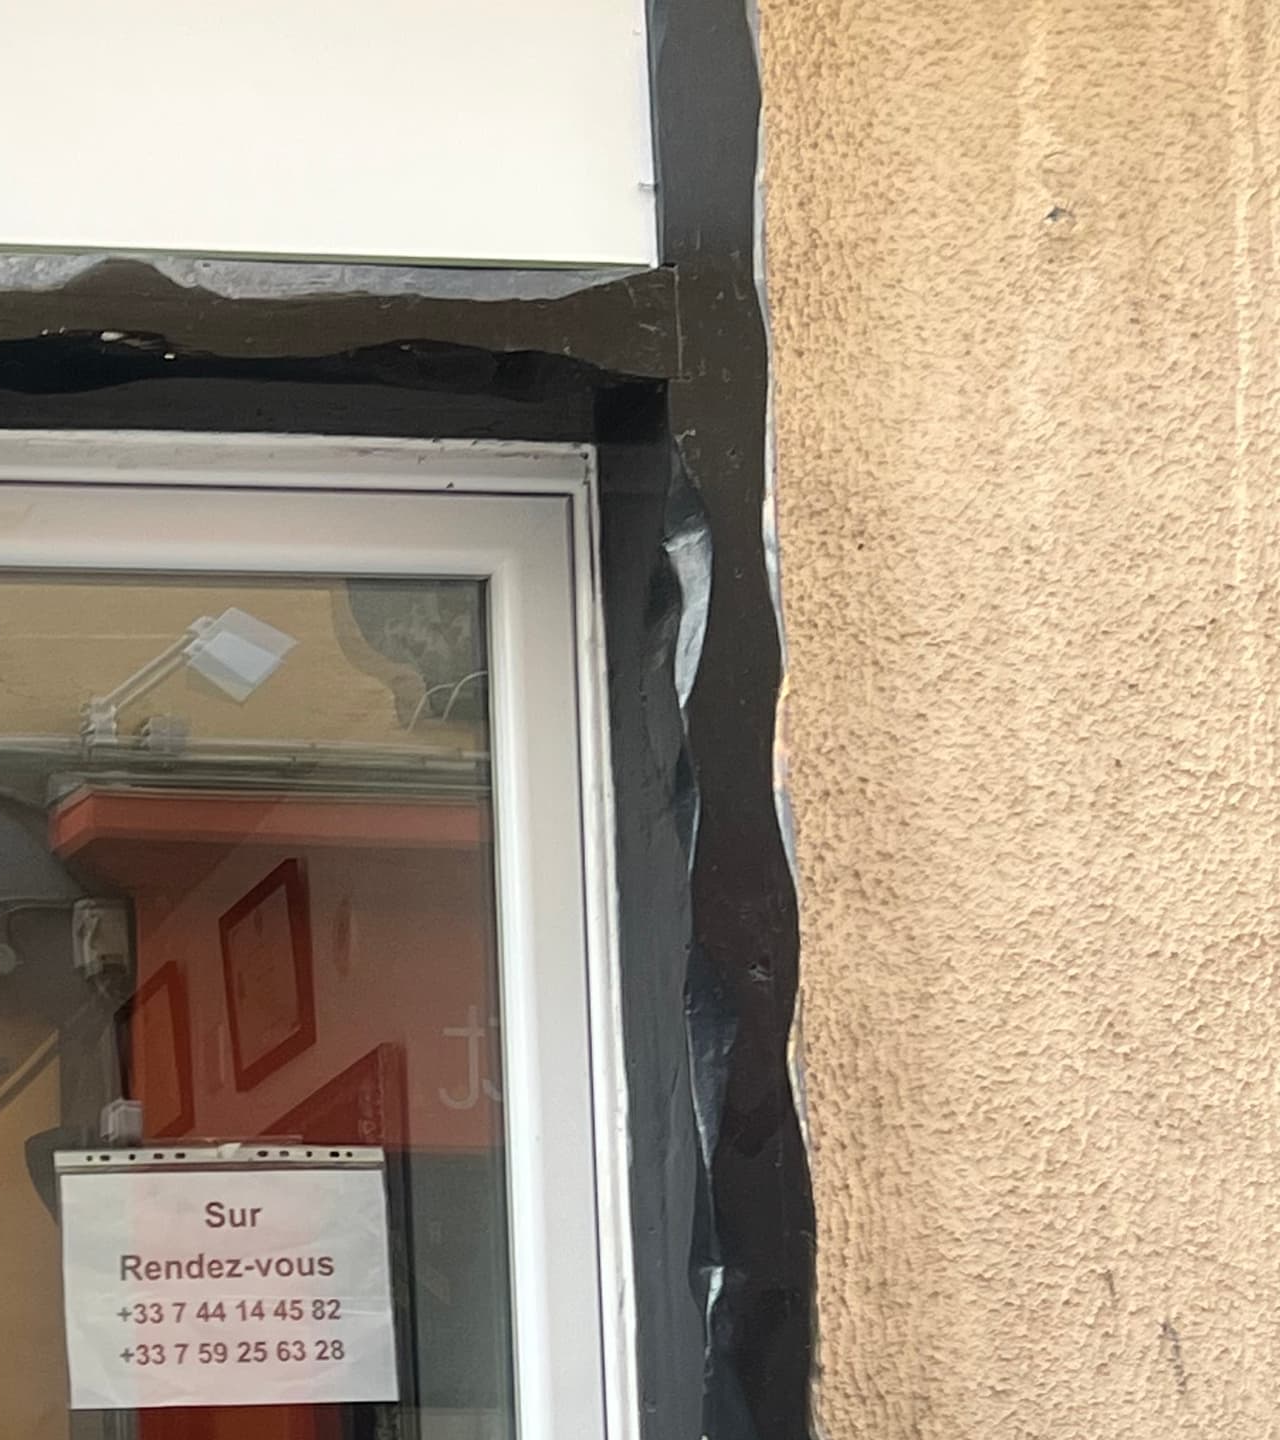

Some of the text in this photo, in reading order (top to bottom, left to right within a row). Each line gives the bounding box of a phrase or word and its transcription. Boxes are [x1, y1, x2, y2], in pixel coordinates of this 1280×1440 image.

[204, 1201, 262, 1228] Sur
[120, 1253, 335, 1281] Rendez-vous
[116, 1299, 341, 1324] +33 7 44 14 45 82
[119, 1339, 345, 1365] +33 7 59 25 63 28
